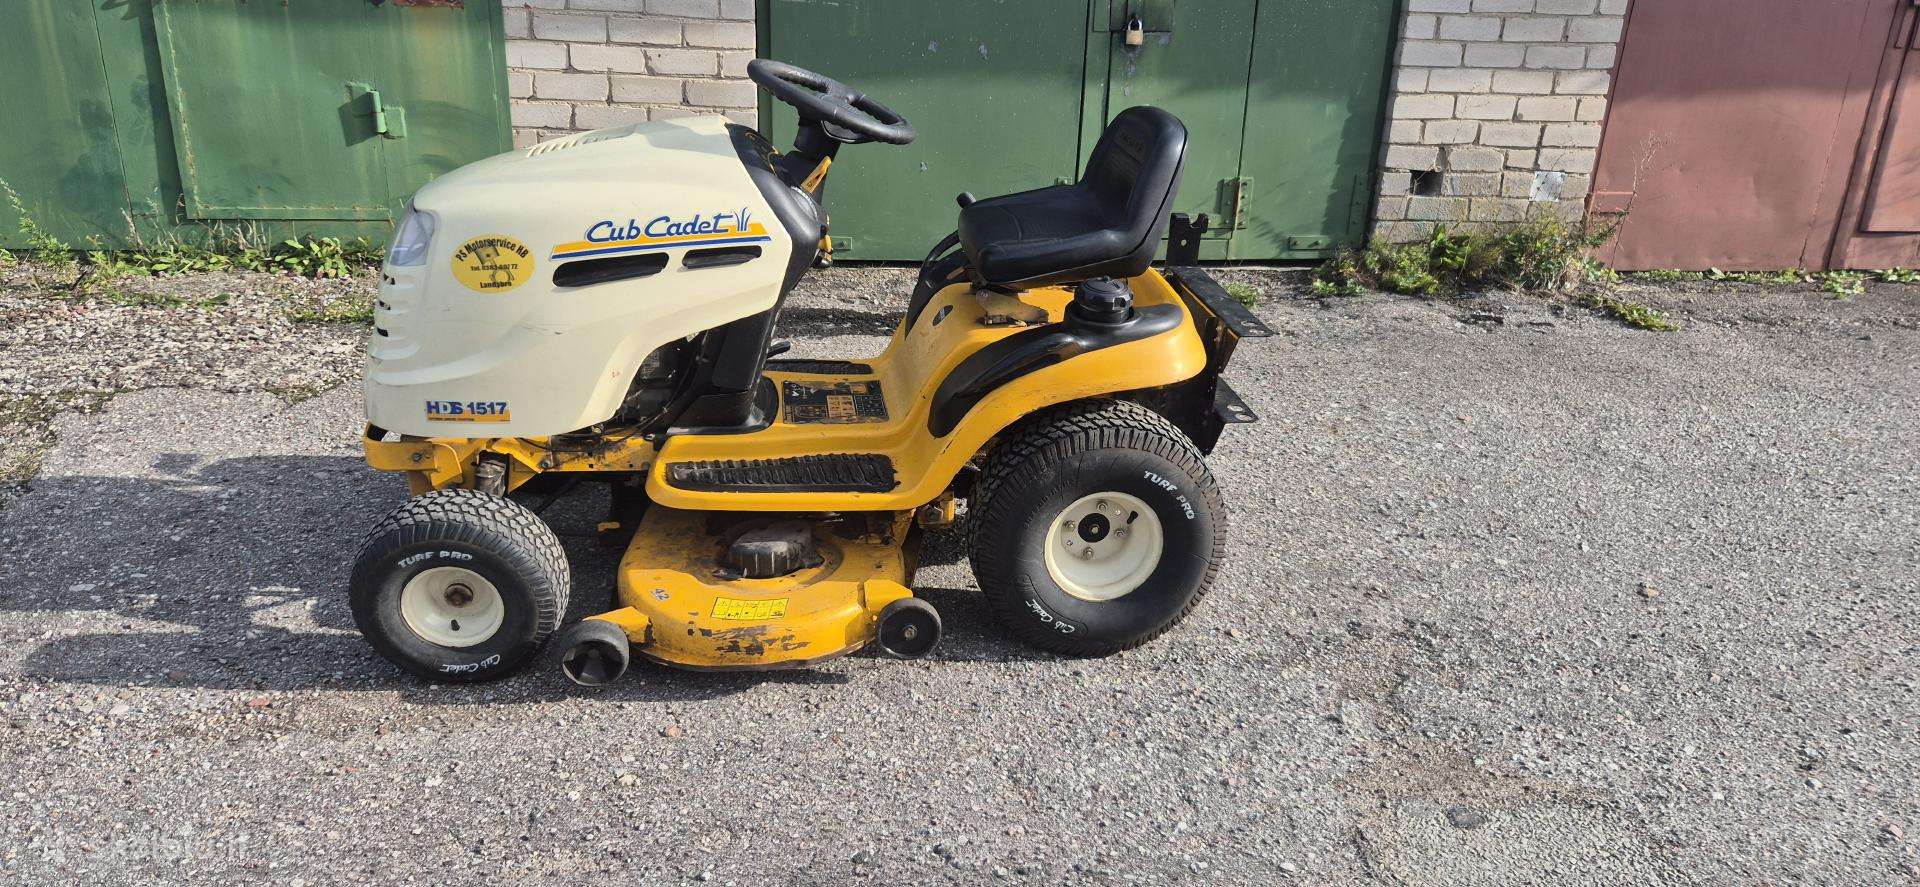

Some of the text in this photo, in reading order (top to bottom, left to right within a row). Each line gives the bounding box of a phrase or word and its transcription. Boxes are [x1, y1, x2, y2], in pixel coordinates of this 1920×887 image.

[587, 213, 733, 243] Cub Cadet
[455, 238, 529, 262] PS Motorservice HB
[426, 400, 507, 415] HDS 1517
[1143, 470, 1195, 520] TURF PRO
[397, 550, 473, 568] TURF PRO
[1025, 598, 1075, 633] Cub Cadet
[439, 654, 501, 674] Cub Cadet
